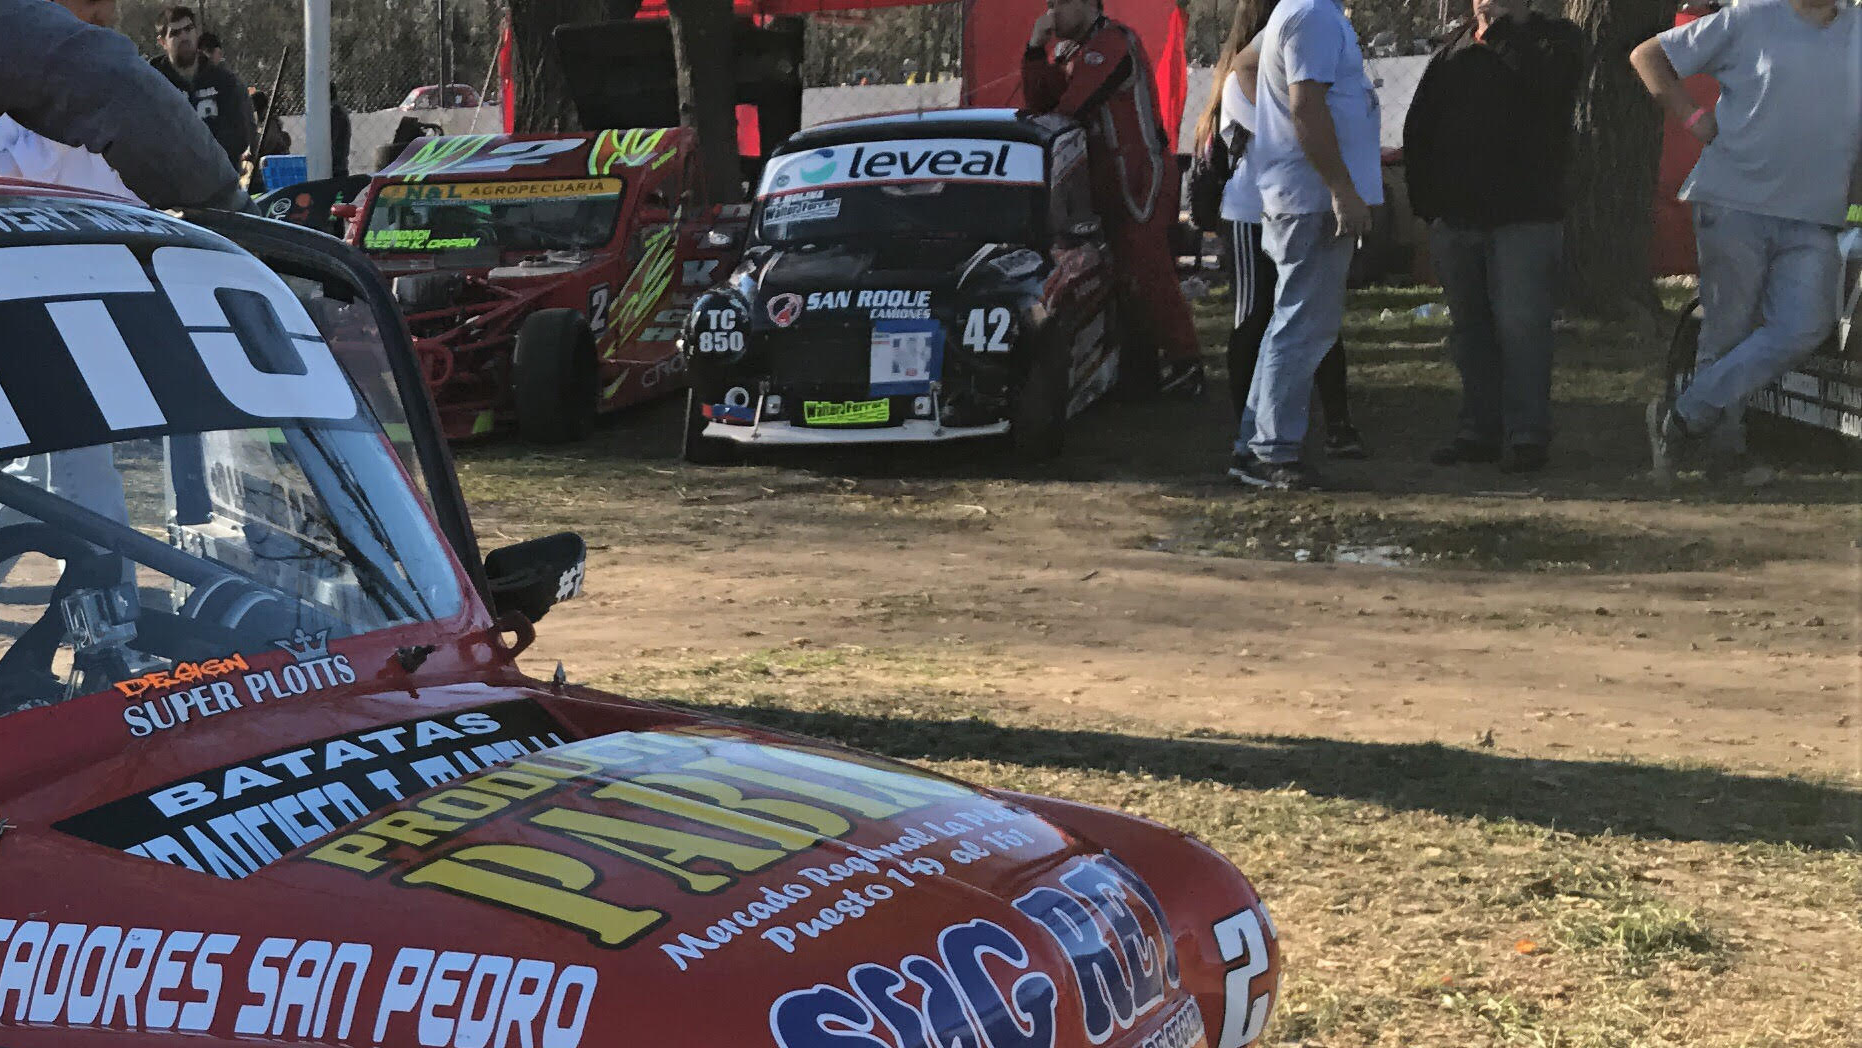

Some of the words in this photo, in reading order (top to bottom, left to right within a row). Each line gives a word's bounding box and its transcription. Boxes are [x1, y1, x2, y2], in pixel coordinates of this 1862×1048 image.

[848, 145, 1010, 178] leveal
[470, 181, 604, 197] AGROPECUARIA
[68, 208, 186, 237] MUCH
[707, 308, 737, 330] TC
[806, 290, 853, 311] SAN
[856, 290, 932, 308] ROQUE
[870, 308, 931, 320] CAMIONES
[699, 331, 744, 352] 850
[962, 307, 1011, 352] 42
[113, 653, 250, 698] DESIGN
[123, 681, 243, 737] SUPER
[148, 713, 501, 817] BATATAS
[660, 883, 812, 972] Mercado
[798, 827, 938, 887] Regional
[922, 820, 975, 838] La
[761, 884, 894, 954] Puesto
[885, 856, 946, 888] 149
[950, 839, 992, 864] al
[234, 936, 372, 1040] SAN
